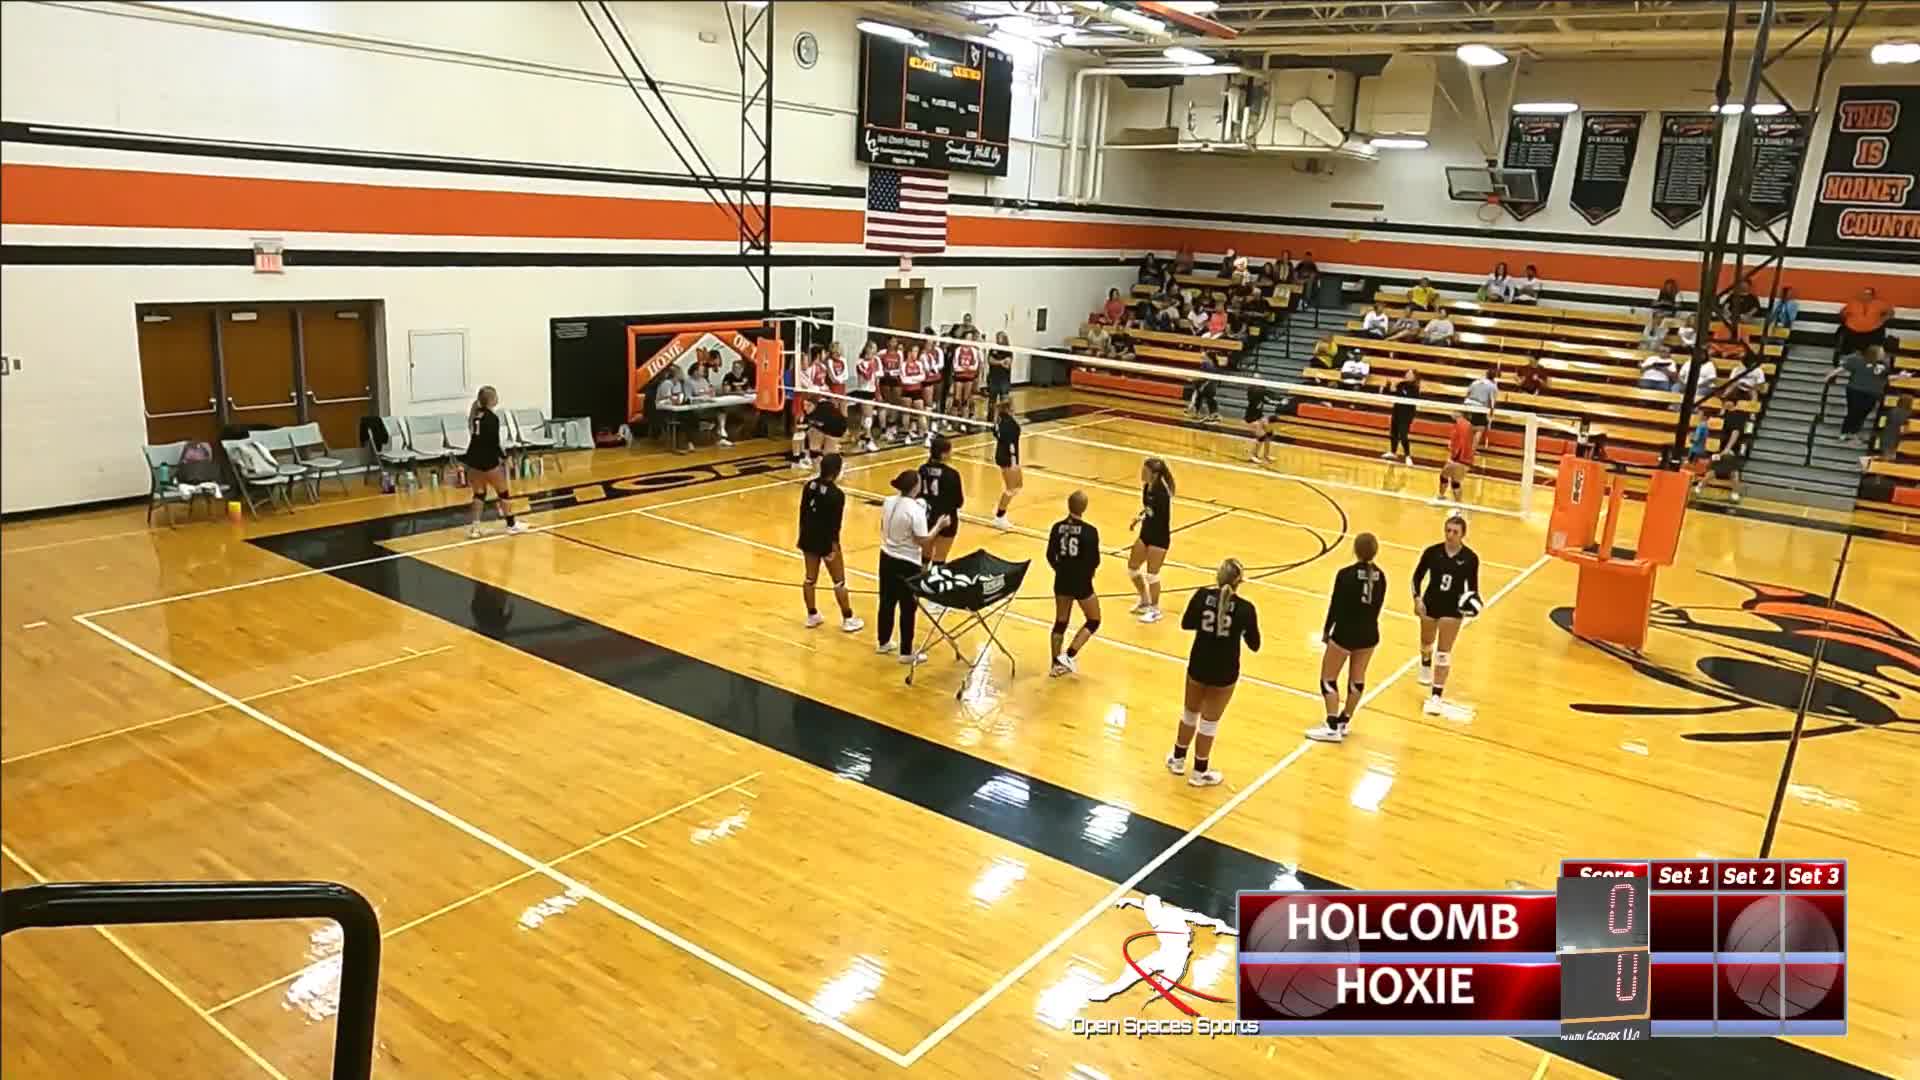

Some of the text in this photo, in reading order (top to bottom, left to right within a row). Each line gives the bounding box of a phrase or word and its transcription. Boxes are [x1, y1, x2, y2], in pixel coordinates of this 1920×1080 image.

[1842, 103, 1897, 130] THIS
[1857, 139, 1886, 166] IS
[1824, 175, 1909, 203] HORNET
[647, 340, 684, 377] HOME
[1440, 574, 1453, 592] 9
